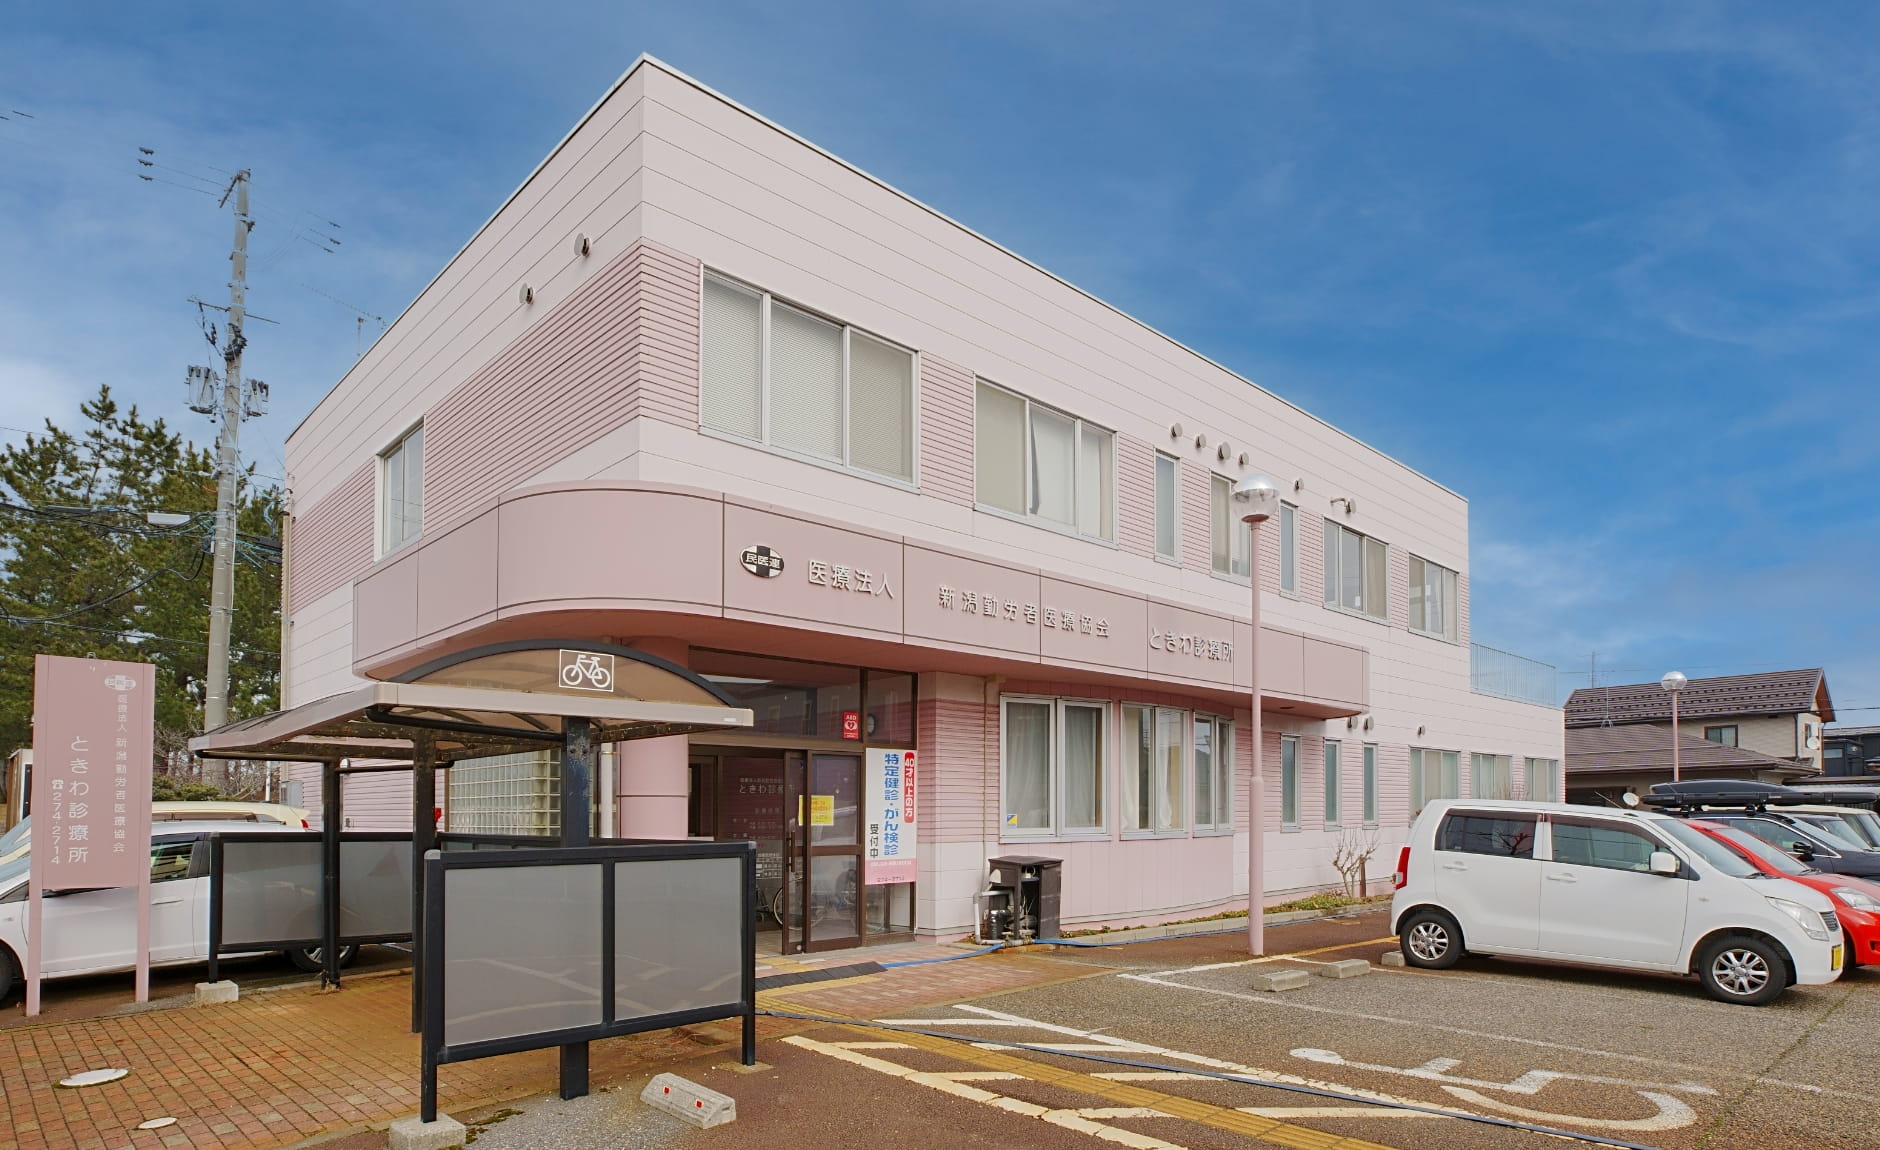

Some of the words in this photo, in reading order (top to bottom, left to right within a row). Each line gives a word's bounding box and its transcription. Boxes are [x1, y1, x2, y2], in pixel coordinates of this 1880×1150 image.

[807, 559, 895, 599] 医療法人
[937, 584, 1111, 639] 新潟勤労者医療協会
[1148, 627, 1234, 663] ときわ診療所
[68, 735, 89, 863] ときわ診療所
[884, 754, 899, 855] 特定健診・がん検診
[904, 759, 914, 816] 40才以上の方
[870, 824, 879, 858] 受付中
